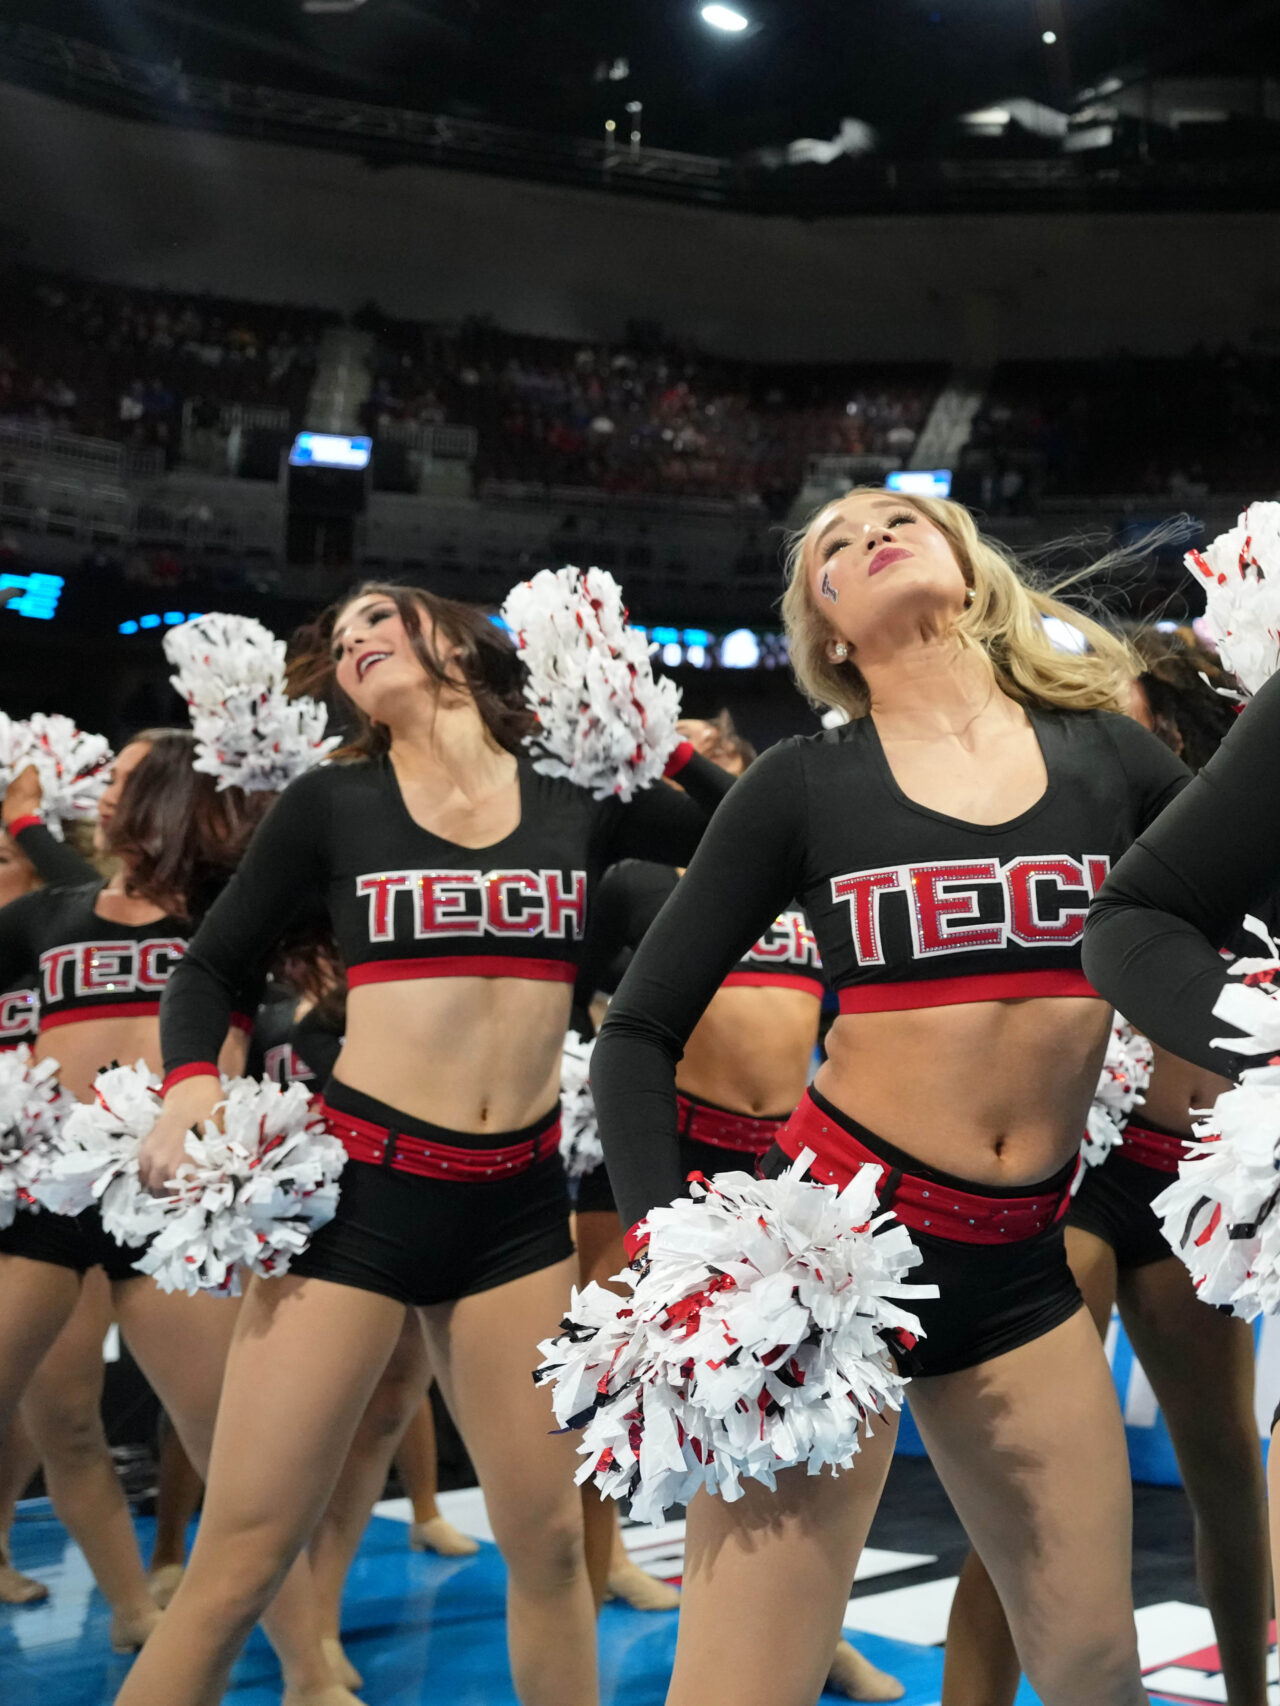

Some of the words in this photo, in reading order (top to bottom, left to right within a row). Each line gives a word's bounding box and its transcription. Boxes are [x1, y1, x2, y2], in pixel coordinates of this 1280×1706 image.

[356, 869, 587, 943] TECH
[741, 911, 823, 969] CH
[830, 854, 1110, 967] TEC
[39, 937, 190, 1004] TEC
